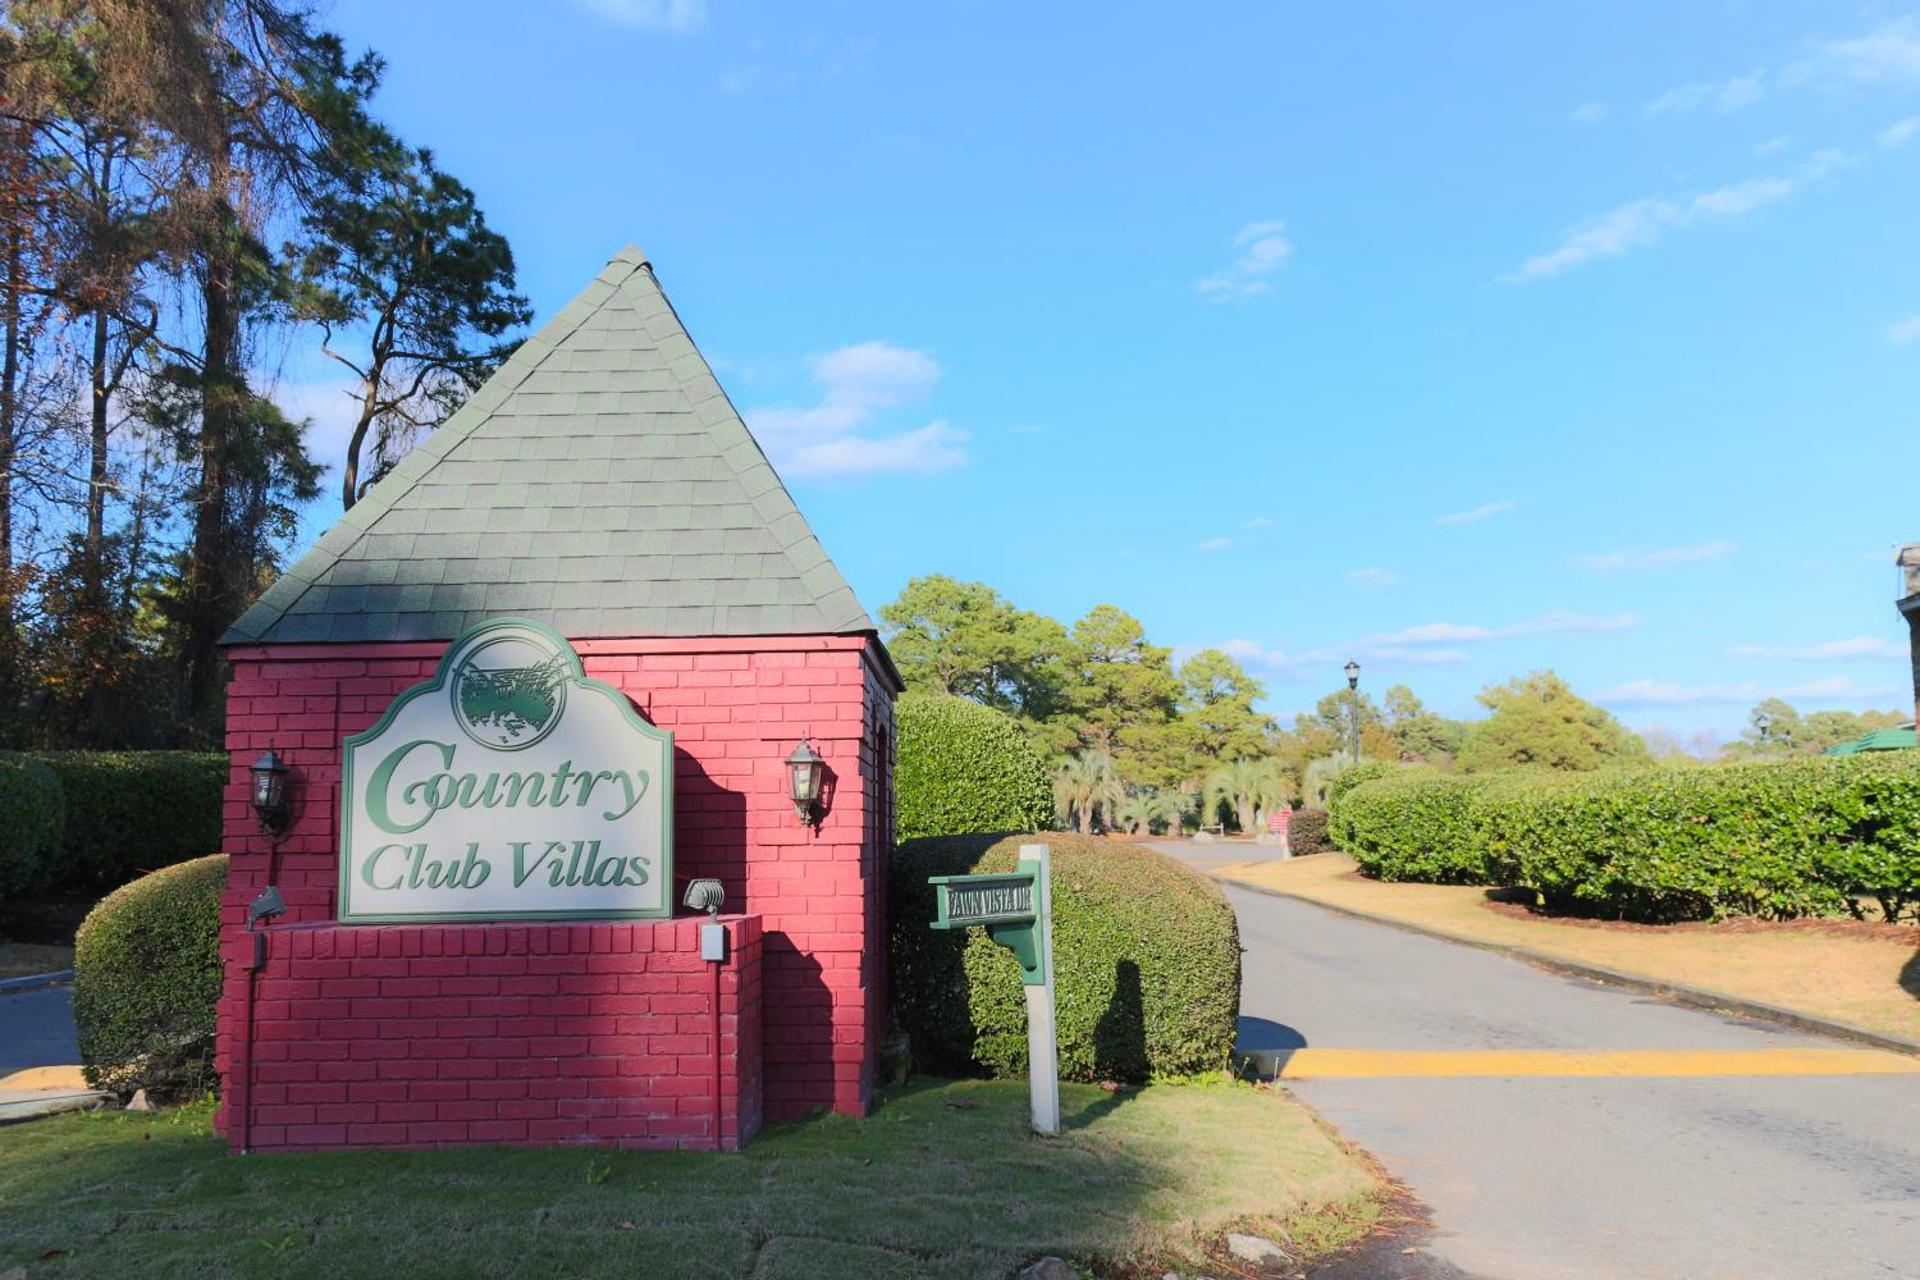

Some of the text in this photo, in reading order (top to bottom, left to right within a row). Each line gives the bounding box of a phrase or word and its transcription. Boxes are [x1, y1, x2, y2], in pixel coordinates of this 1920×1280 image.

[365, 739, 650, 834] Country
[361, 840, 651, 890] Club Villas
[981, 887, 1011, 914] VISTA
